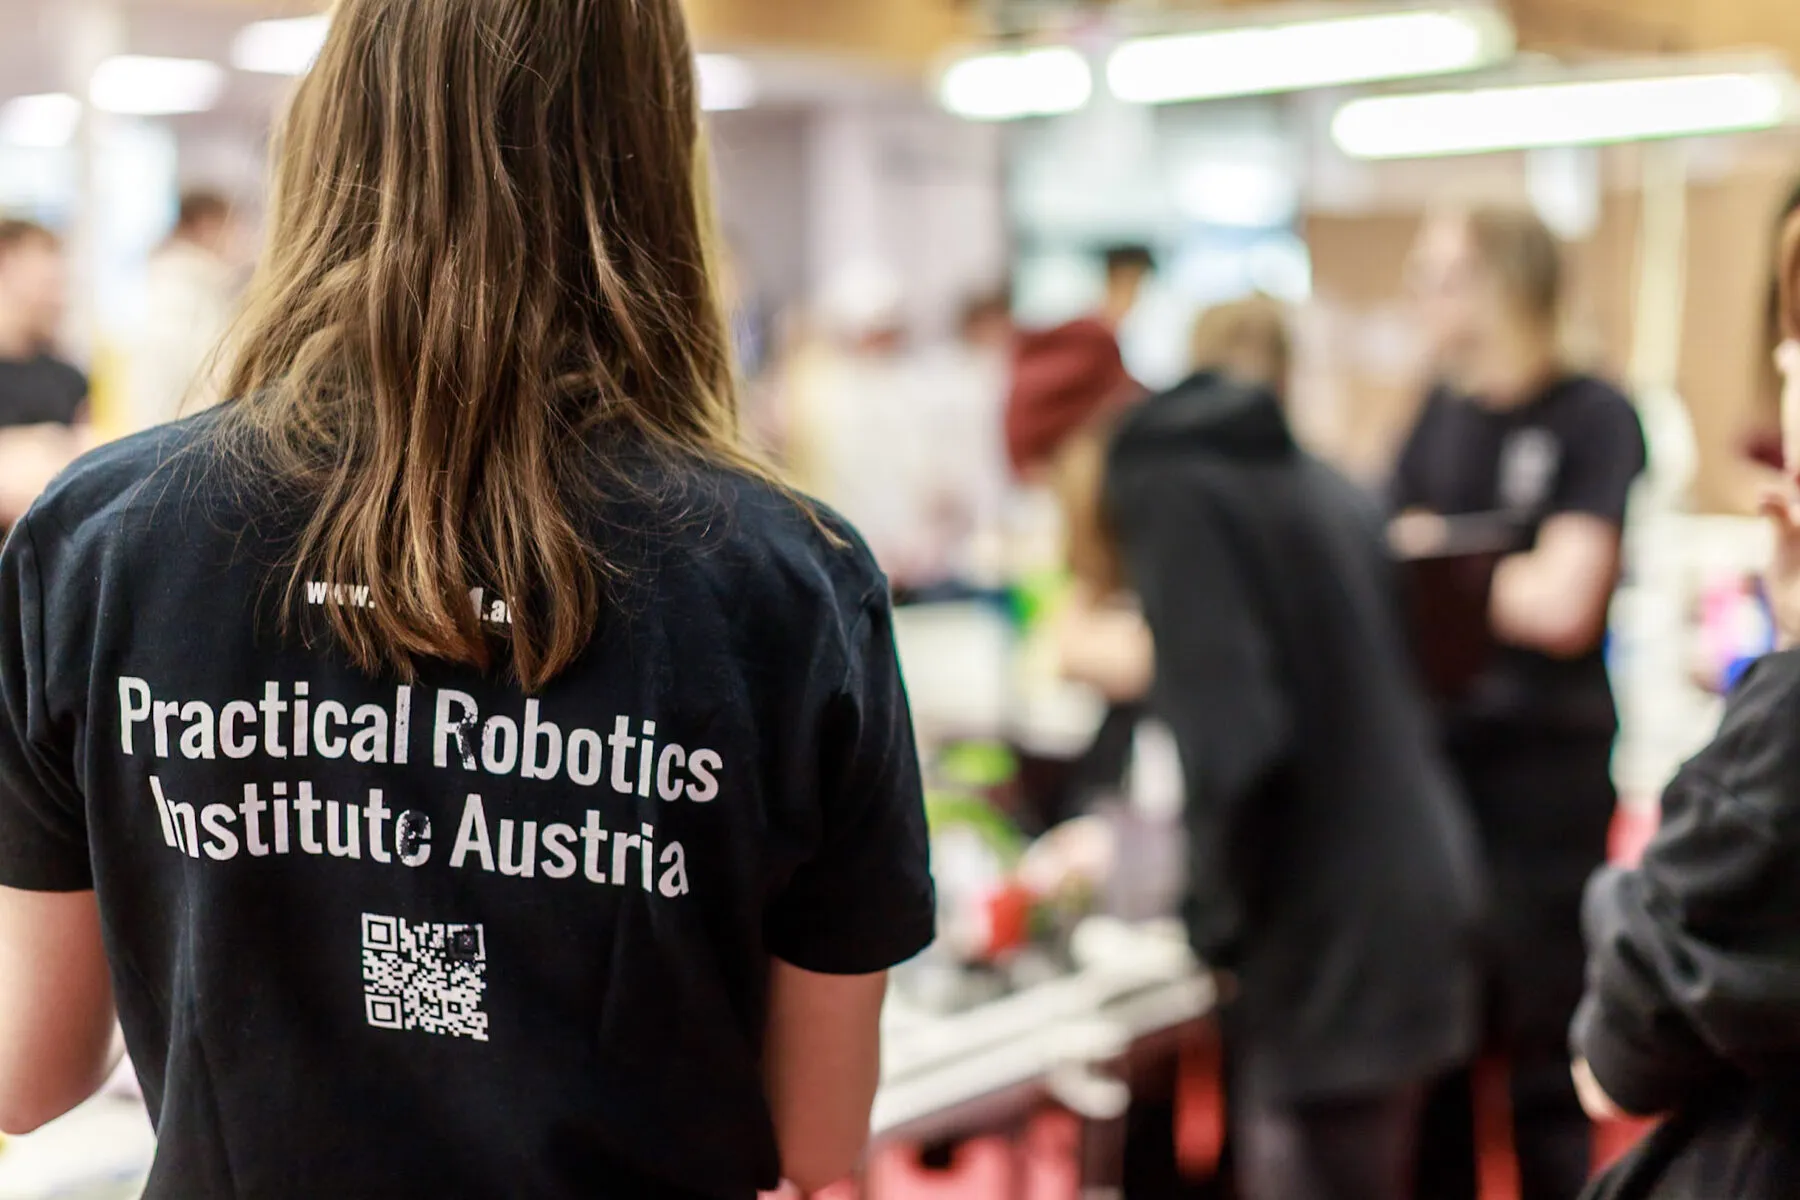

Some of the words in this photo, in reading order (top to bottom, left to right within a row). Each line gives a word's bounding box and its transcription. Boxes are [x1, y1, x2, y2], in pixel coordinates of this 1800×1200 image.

[118, 675, 410, 765] Practical
[434, 689, 723, 803] Robotics
[149, 775, 432, 867] Institute
[449, 793, 689, 898] Austria
